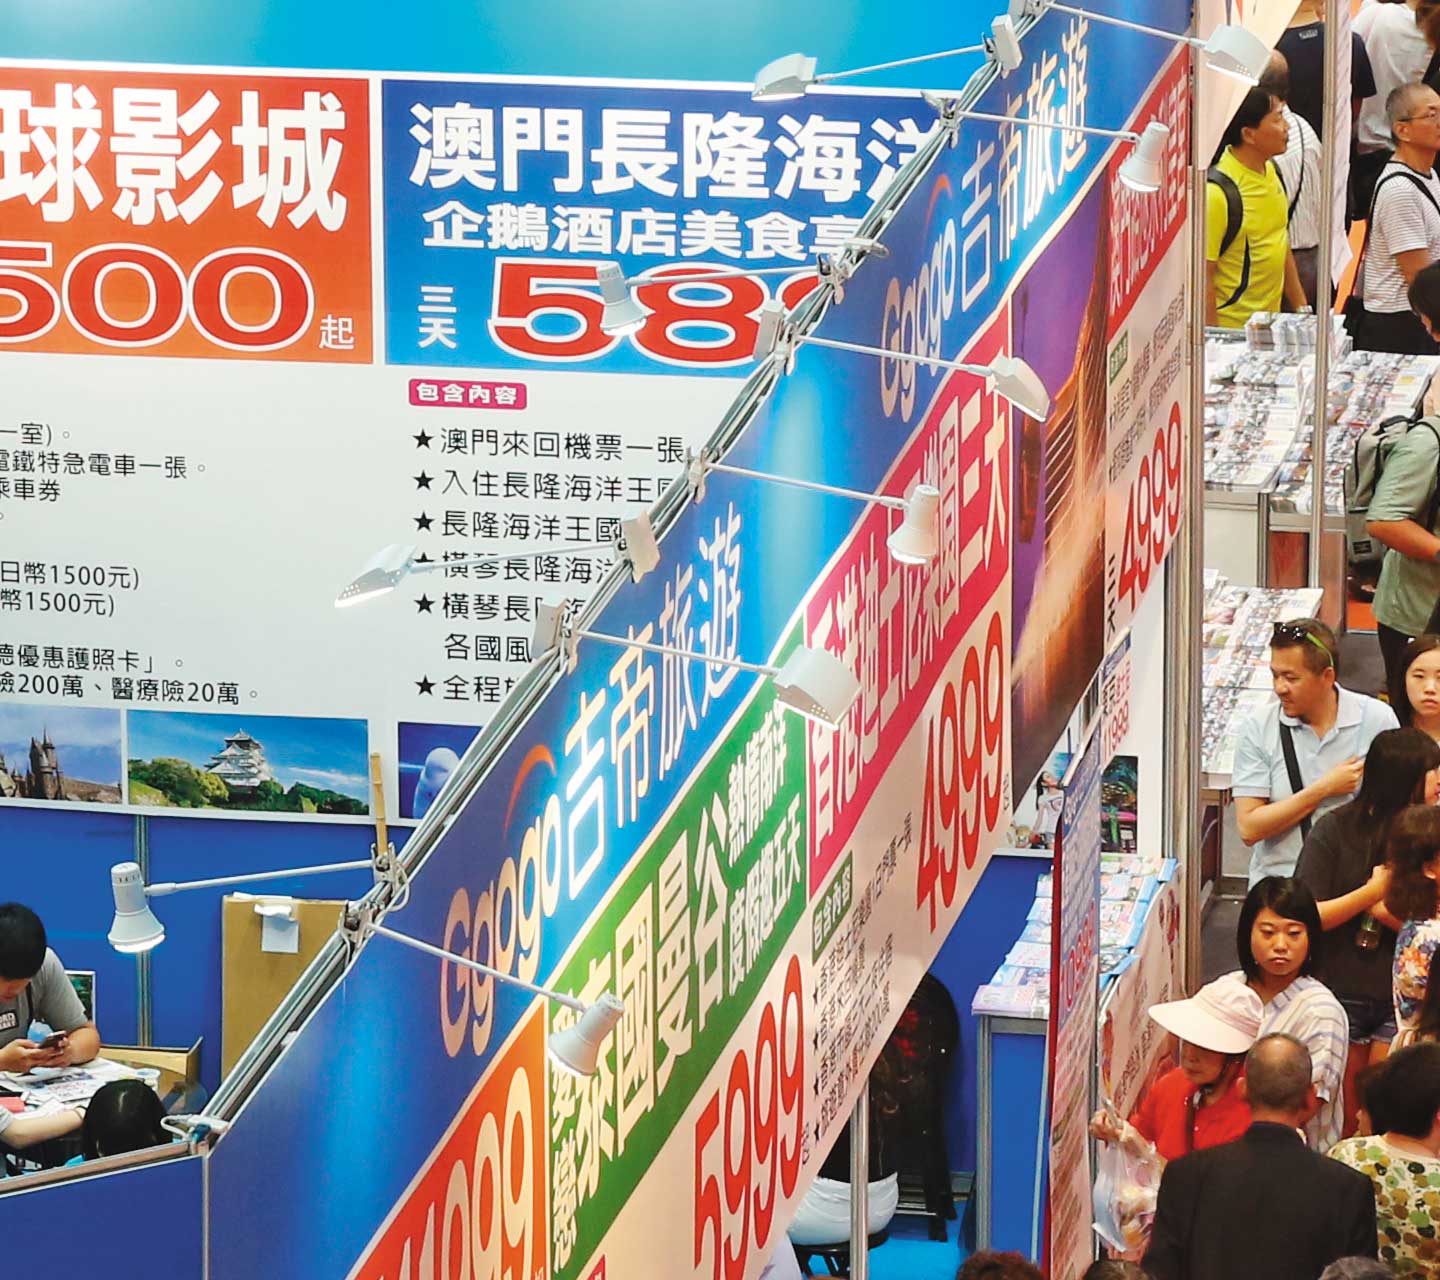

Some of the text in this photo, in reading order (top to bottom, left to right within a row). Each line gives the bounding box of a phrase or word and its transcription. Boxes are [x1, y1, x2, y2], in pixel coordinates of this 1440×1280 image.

[318, 315, 357, 351] 起
[416, 382, 518, 405] 包含內容
[917, 607, 1007, 935] 4999
[438, 792, 563, 1060] Ggogo
